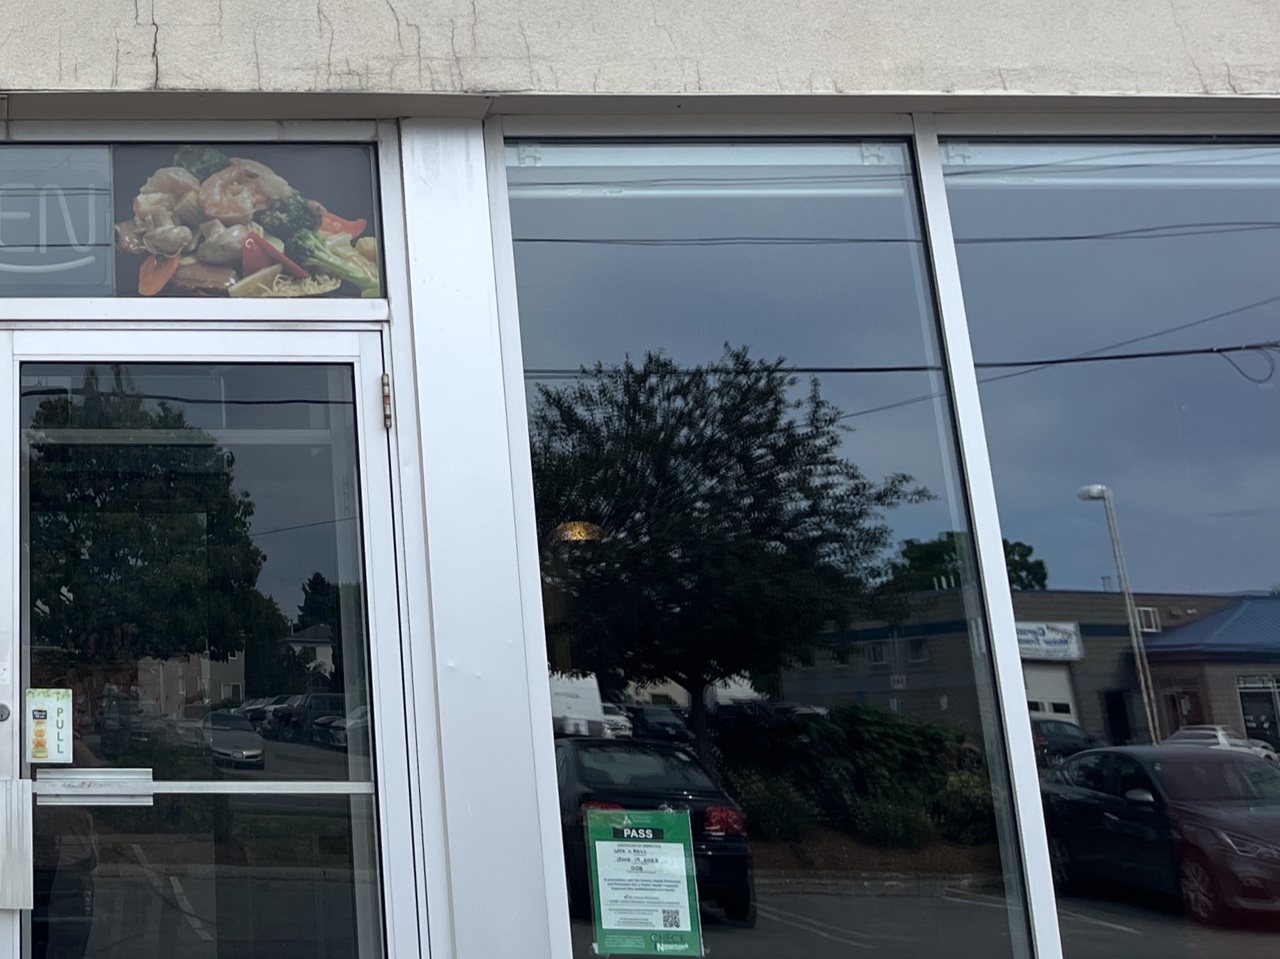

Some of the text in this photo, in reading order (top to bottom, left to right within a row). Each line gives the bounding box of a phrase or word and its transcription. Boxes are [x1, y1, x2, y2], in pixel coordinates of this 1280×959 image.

[56, 707, 64, 754] PULL
[624, 828, 653, 838] PASS
[650, 933, 686, 944] CHECK
